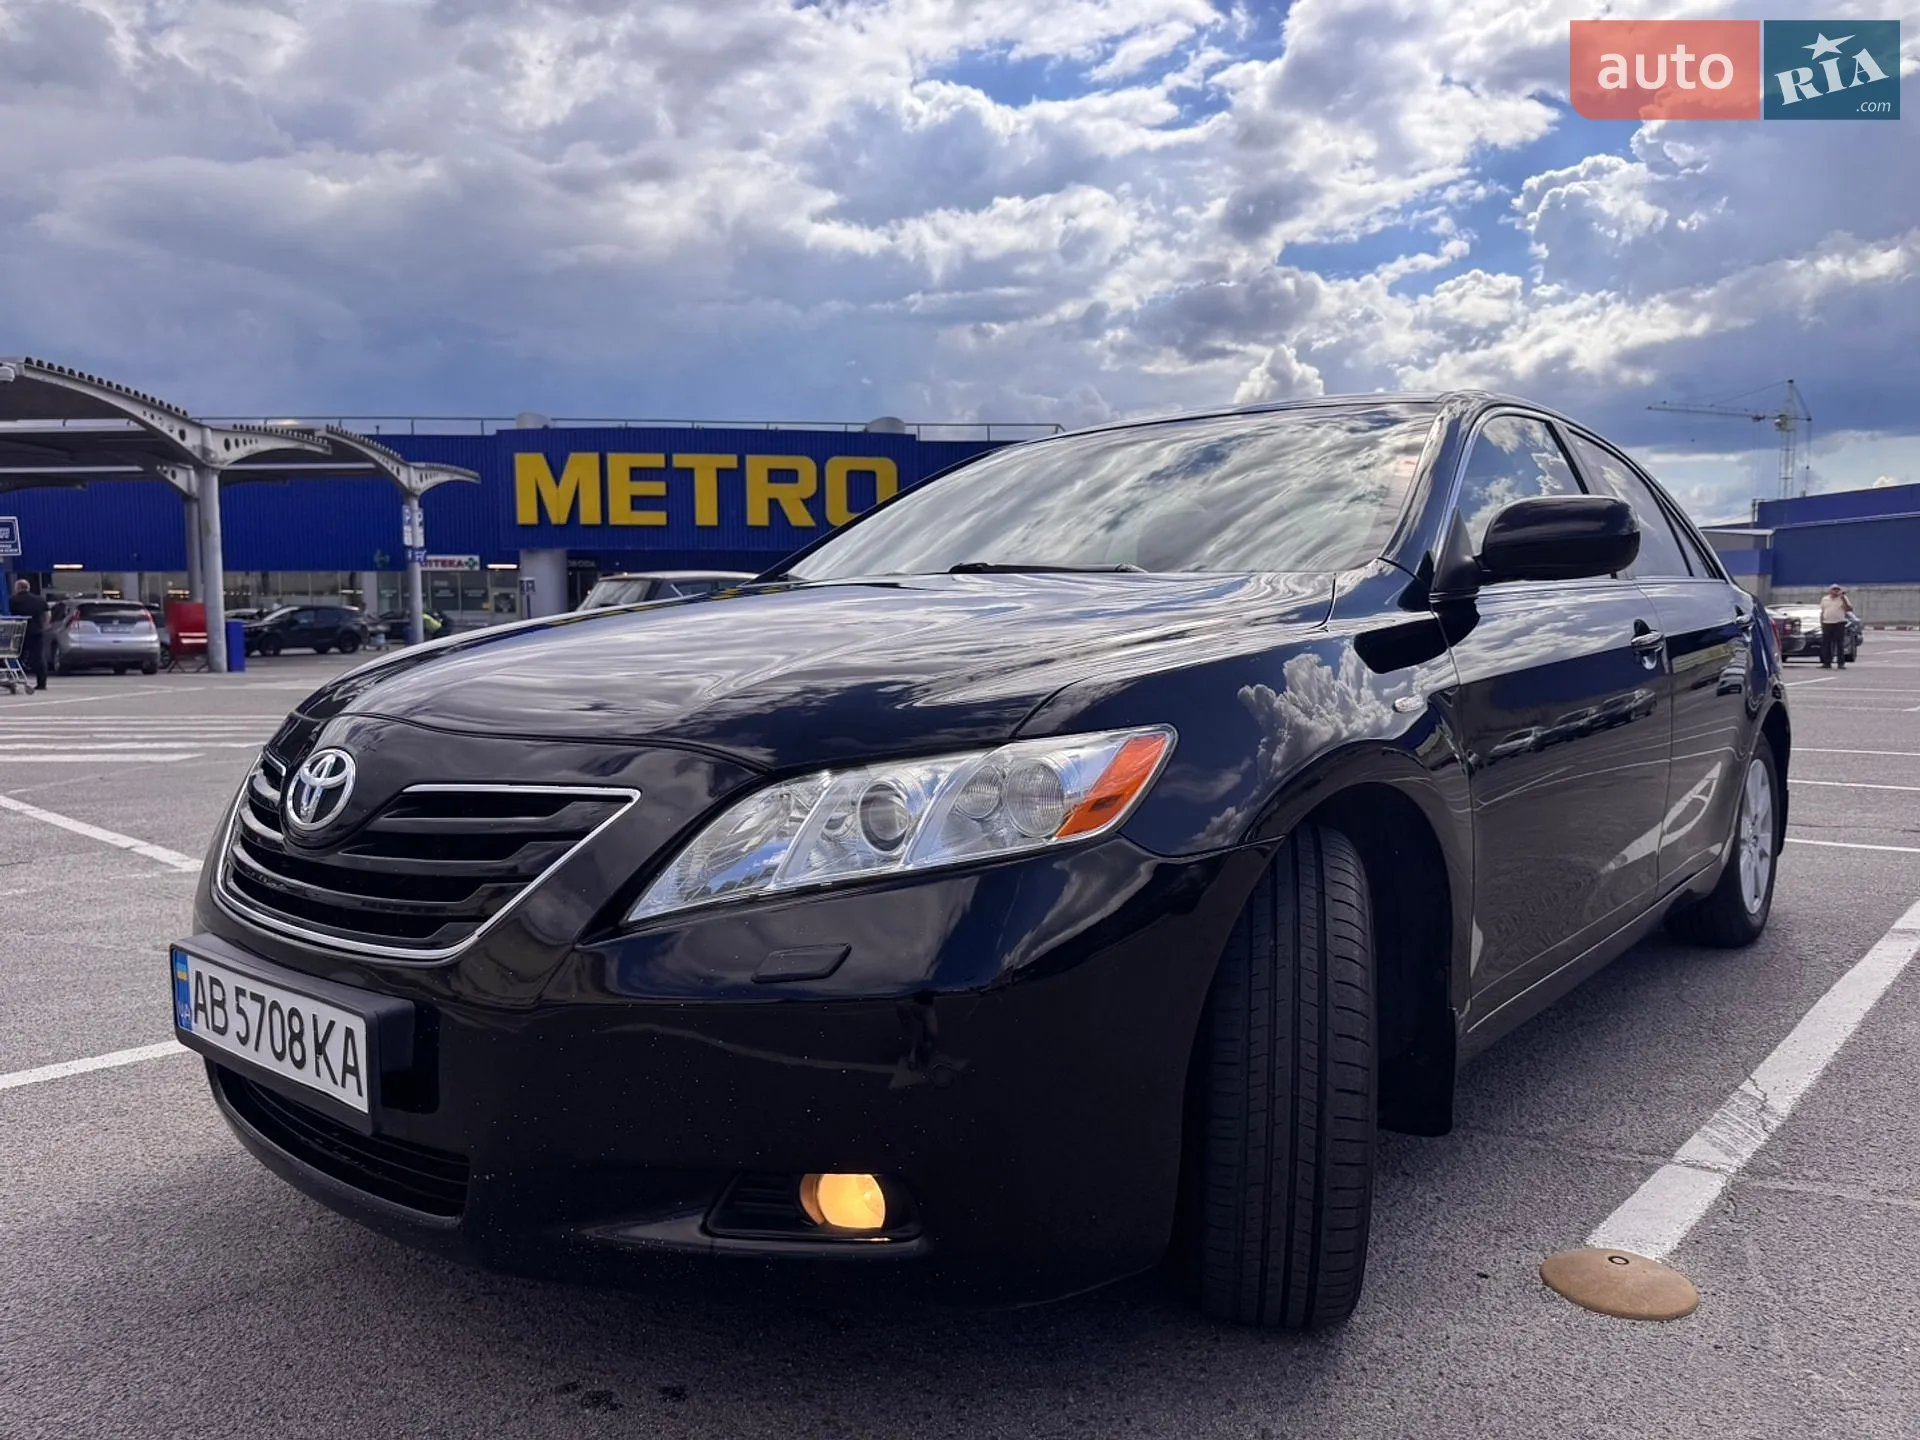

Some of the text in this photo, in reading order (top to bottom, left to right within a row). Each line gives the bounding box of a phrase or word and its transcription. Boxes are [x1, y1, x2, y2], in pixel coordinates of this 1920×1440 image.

[514, 452, 898, 526] METRO
[193, 970, 363, 1098] AB 5708 KA
